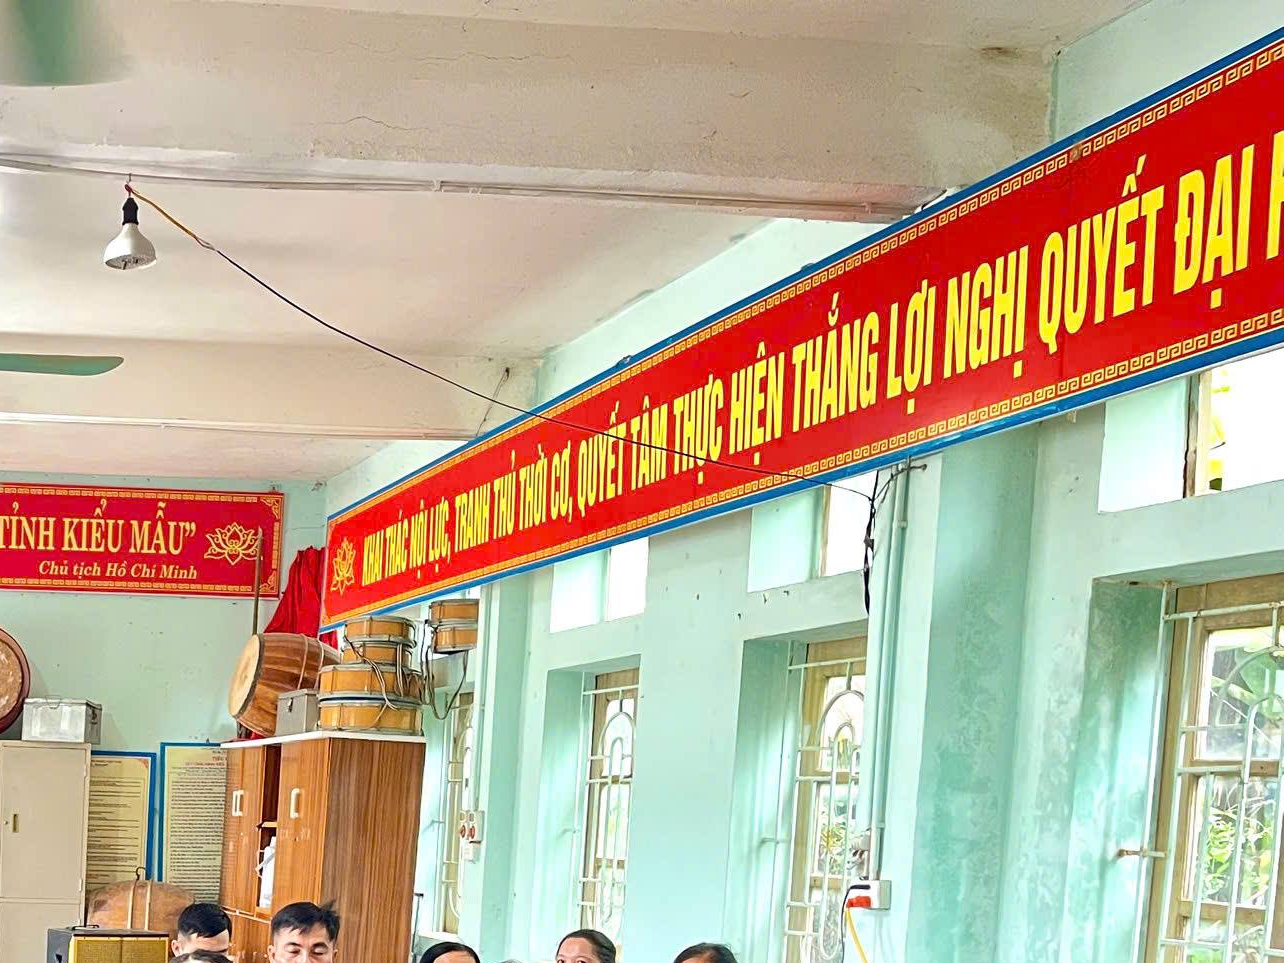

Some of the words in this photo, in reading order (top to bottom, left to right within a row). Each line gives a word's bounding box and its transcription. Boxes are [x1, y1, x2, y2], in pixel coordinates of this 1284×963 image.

[362, 529, 385, 586] KHAI
[384, 509, 409, 579] THÁC
[410, 498, 428, 579] NỘI
[428, 496, 451, 573] LỰC,
[454, 482, 491, 553] TRANH
[493, 450, 516, 539] THỦ
[519, 443, 547, 531] THỜI
[551, 440, 573, 523] CƠ,
[577, 400, 626, 518] QUYẾT
[630, 395, 668, 491] TÂM
[673, 373, 724, 485] THỰC
[729, 341, 785, 466] HIỆN
[792, 291, 879, 433] THẮNG
[886, 279, 936, 415] LỢI
[943, 245, 1029, 379] NGHỊ
[1038, 154, 1165, 355] QUYẾT
[1173, 143, 1255, 310] ĐẠI
[61, 499, 124, 553] KIỂU
[38, 560, 70, 576] Chủ
[72, 562, 101, 579] tịch
[105, 560, 127, 577] Hồ
[160, 564, 197, 580] Minh
